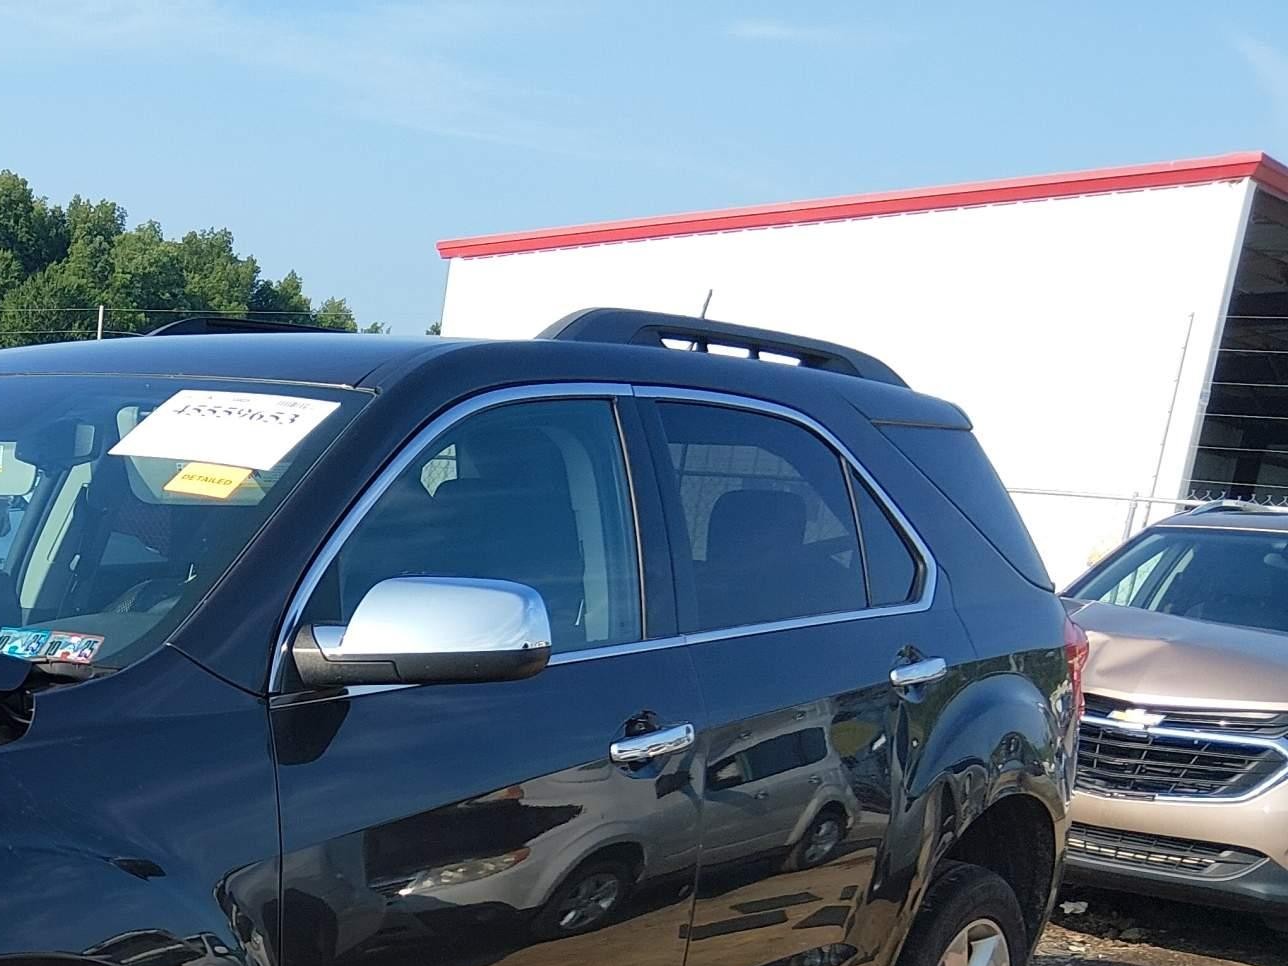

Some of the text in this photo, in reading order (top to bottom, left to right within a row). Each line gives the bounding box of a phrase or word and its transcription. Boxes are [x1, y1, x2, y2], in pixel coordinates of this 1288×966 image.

[172, 403, 300, 424] 45559653
[181, 473, 233, 486] DETAILED
[26, 634, 47, 653] 25
[44, 640, 62, 656] 10
[78, 640, 99, 659] 25
